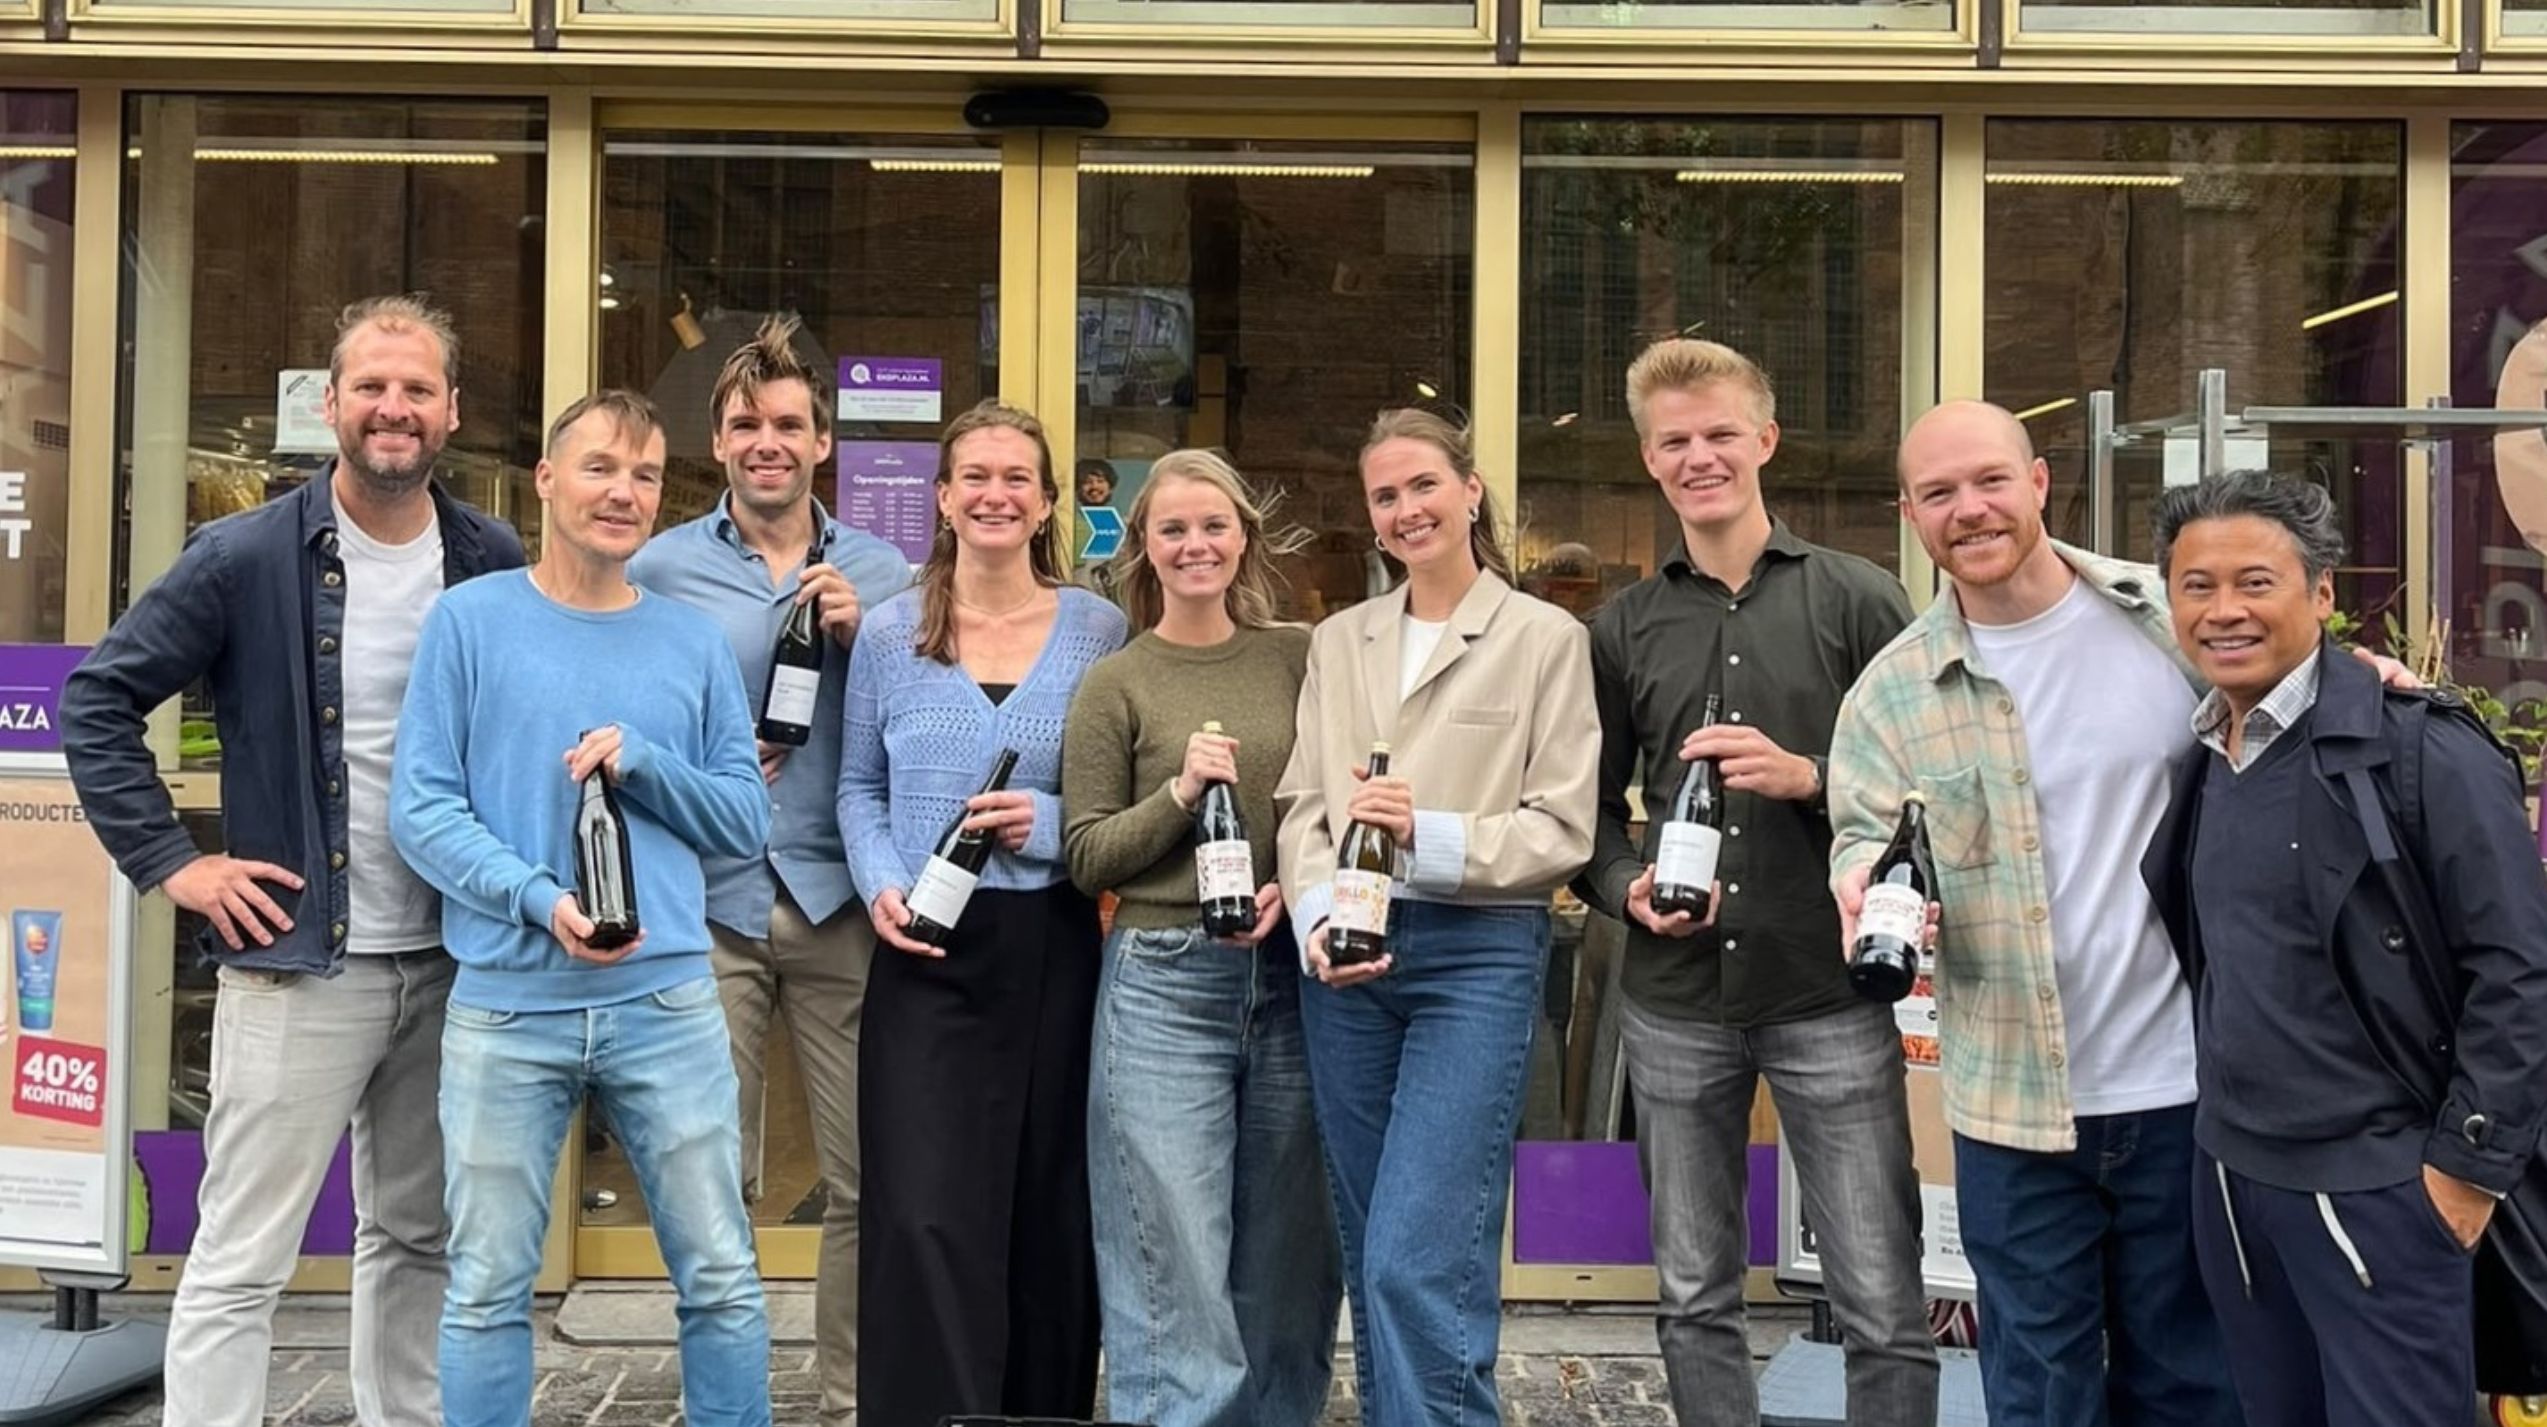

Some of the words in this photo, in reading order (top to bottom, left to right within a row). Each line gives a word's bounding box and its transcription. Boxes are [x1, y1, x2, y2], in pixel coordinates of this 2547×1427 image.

[852, 473, 925, 486] Openingstijden
[0, 703, 51, 731] AZA
[0, 802, 86, 823] RODUCTE
[22, 1050, 99, 1092] 40%
[20, 1083, 96, 1113] KORTING
